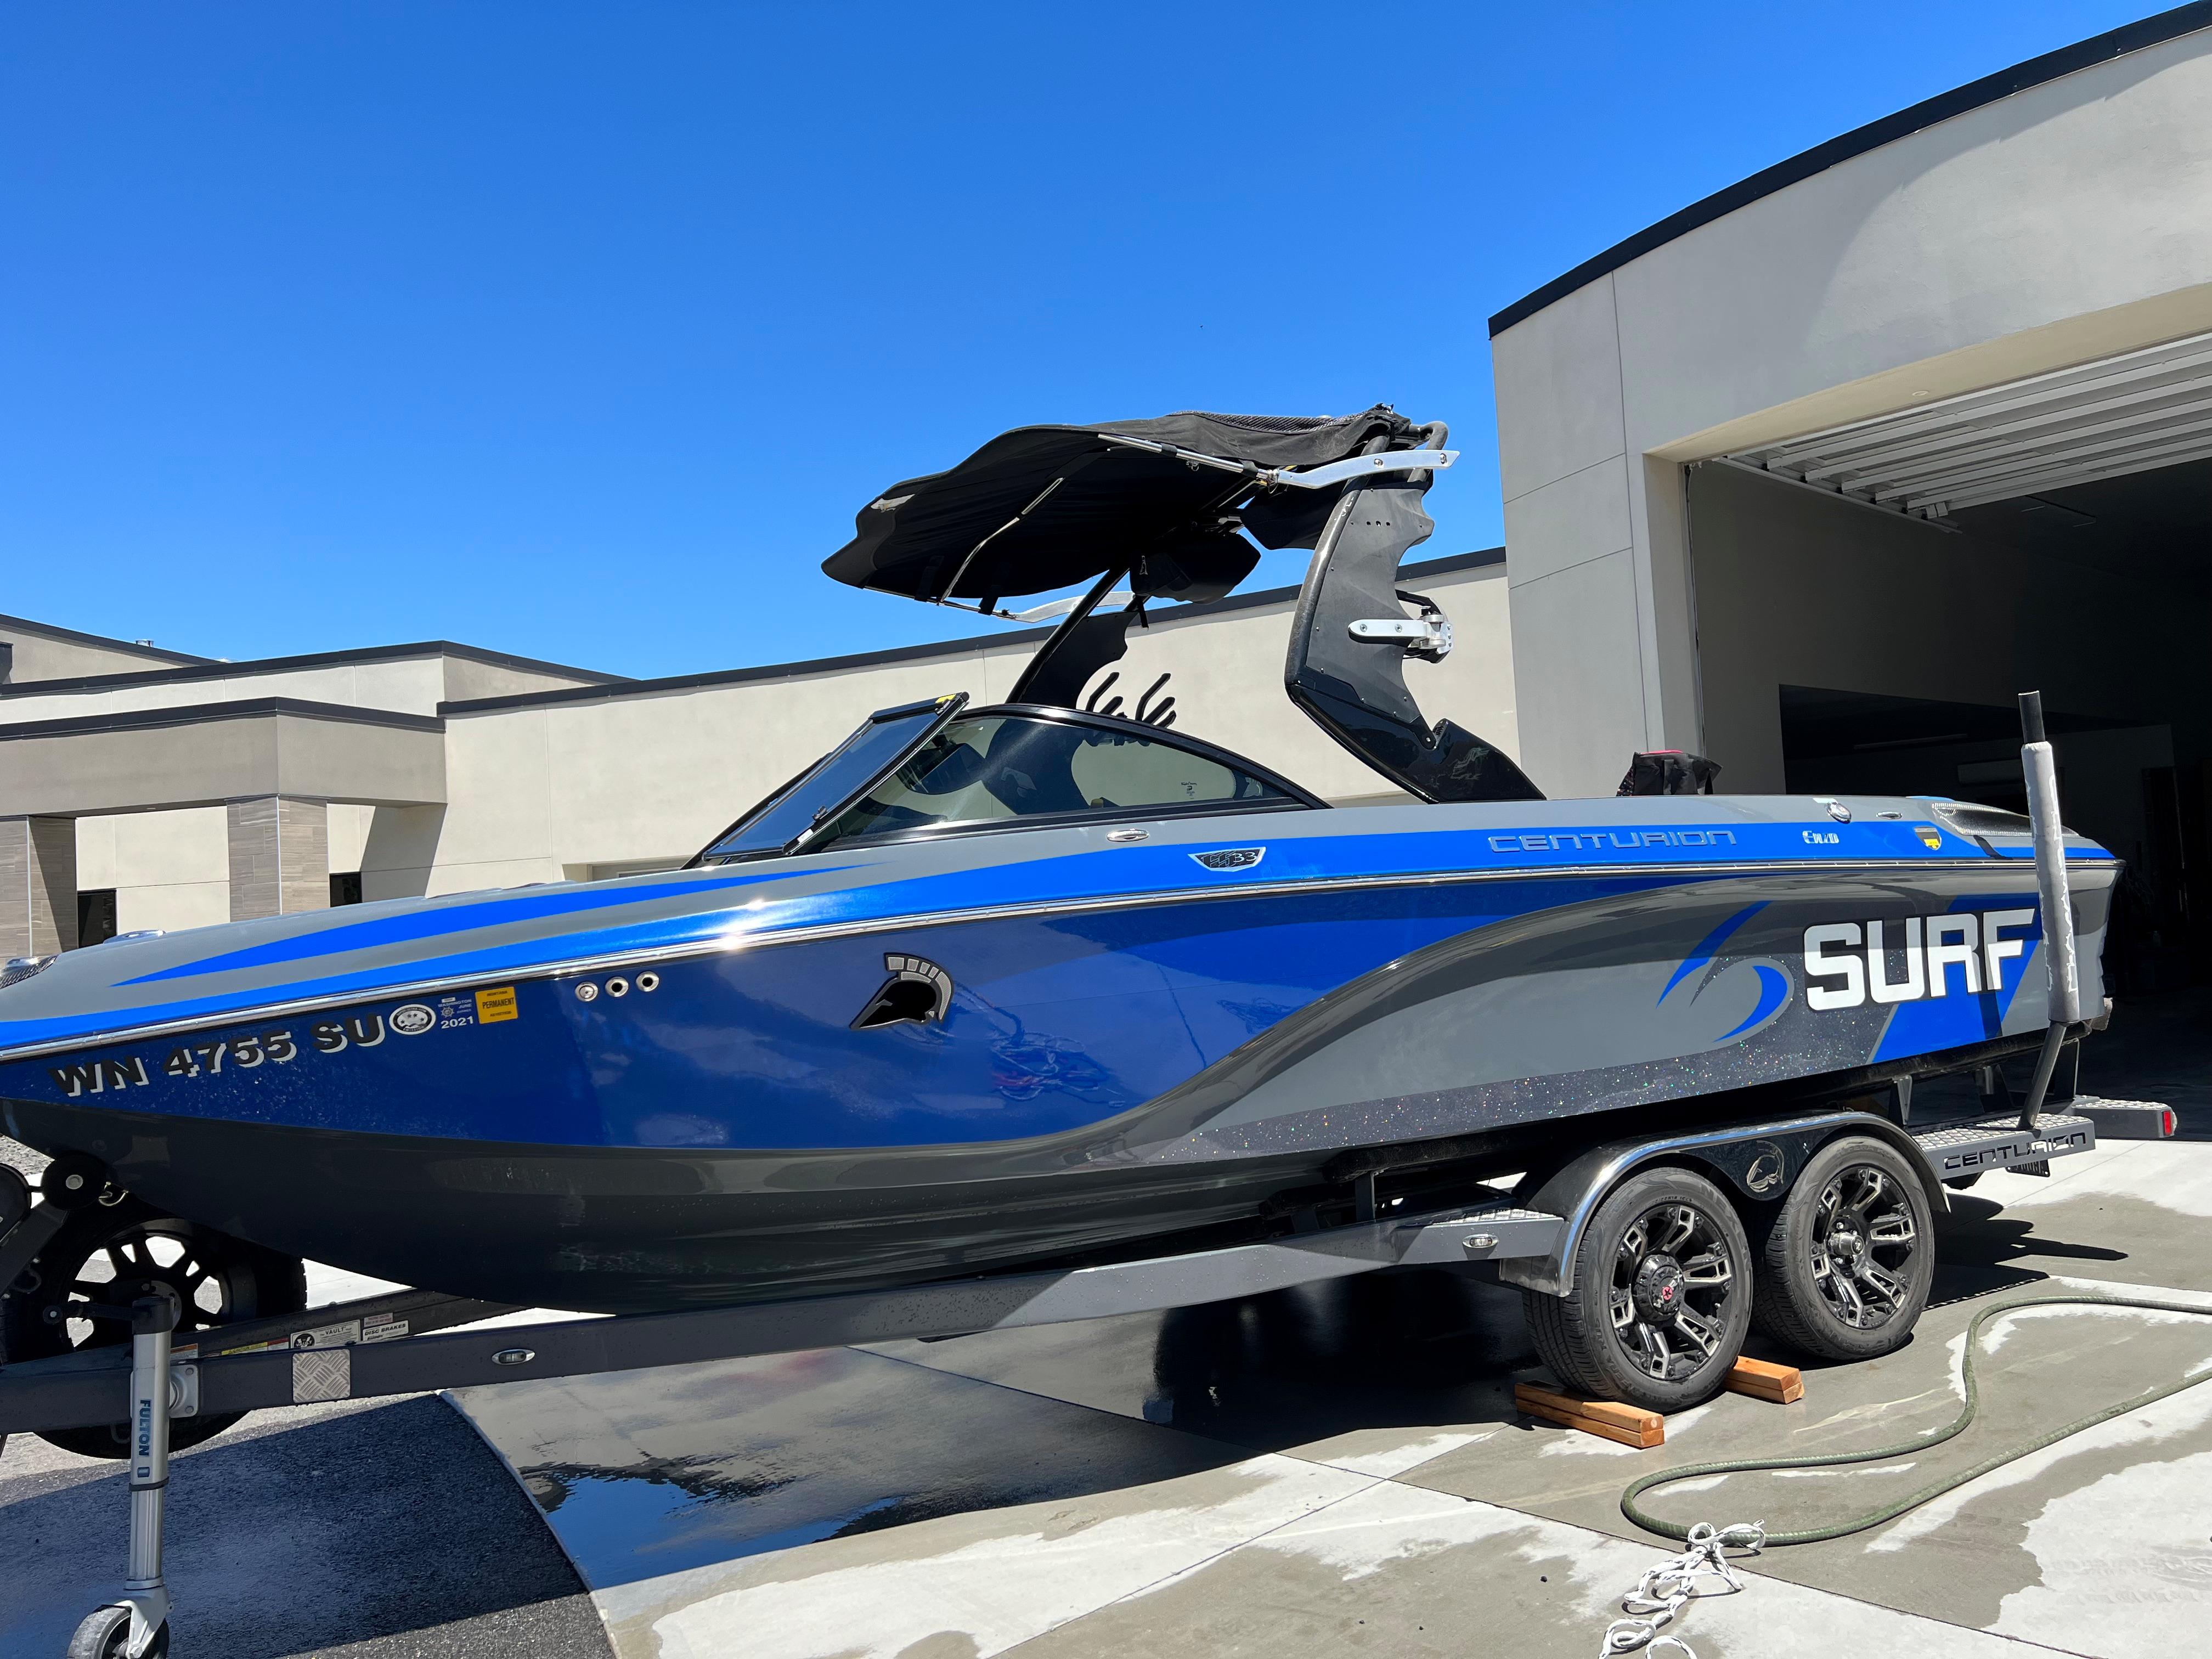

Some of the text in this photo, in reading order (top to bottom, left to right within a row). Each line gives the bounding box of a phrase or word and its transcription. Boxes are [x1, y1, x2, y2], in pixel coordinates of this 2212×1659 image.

[1488, 830, 1737, 853] CENTURION
[1803, 908, 2035, 1011] SURF
[482, 997, 515, 1010] PERMANENT
[441, 1015, 474, 1029] 2021
[49, 1012, 385, 1097] WN 4755 SU
[1944, 1132, 2086, 1170] CENTURION
[364, 1328, 380, 1336] DISC
[381, 1323, 407, 1333] BRAKES
[138, 1400, 151, 1457] FULTON
